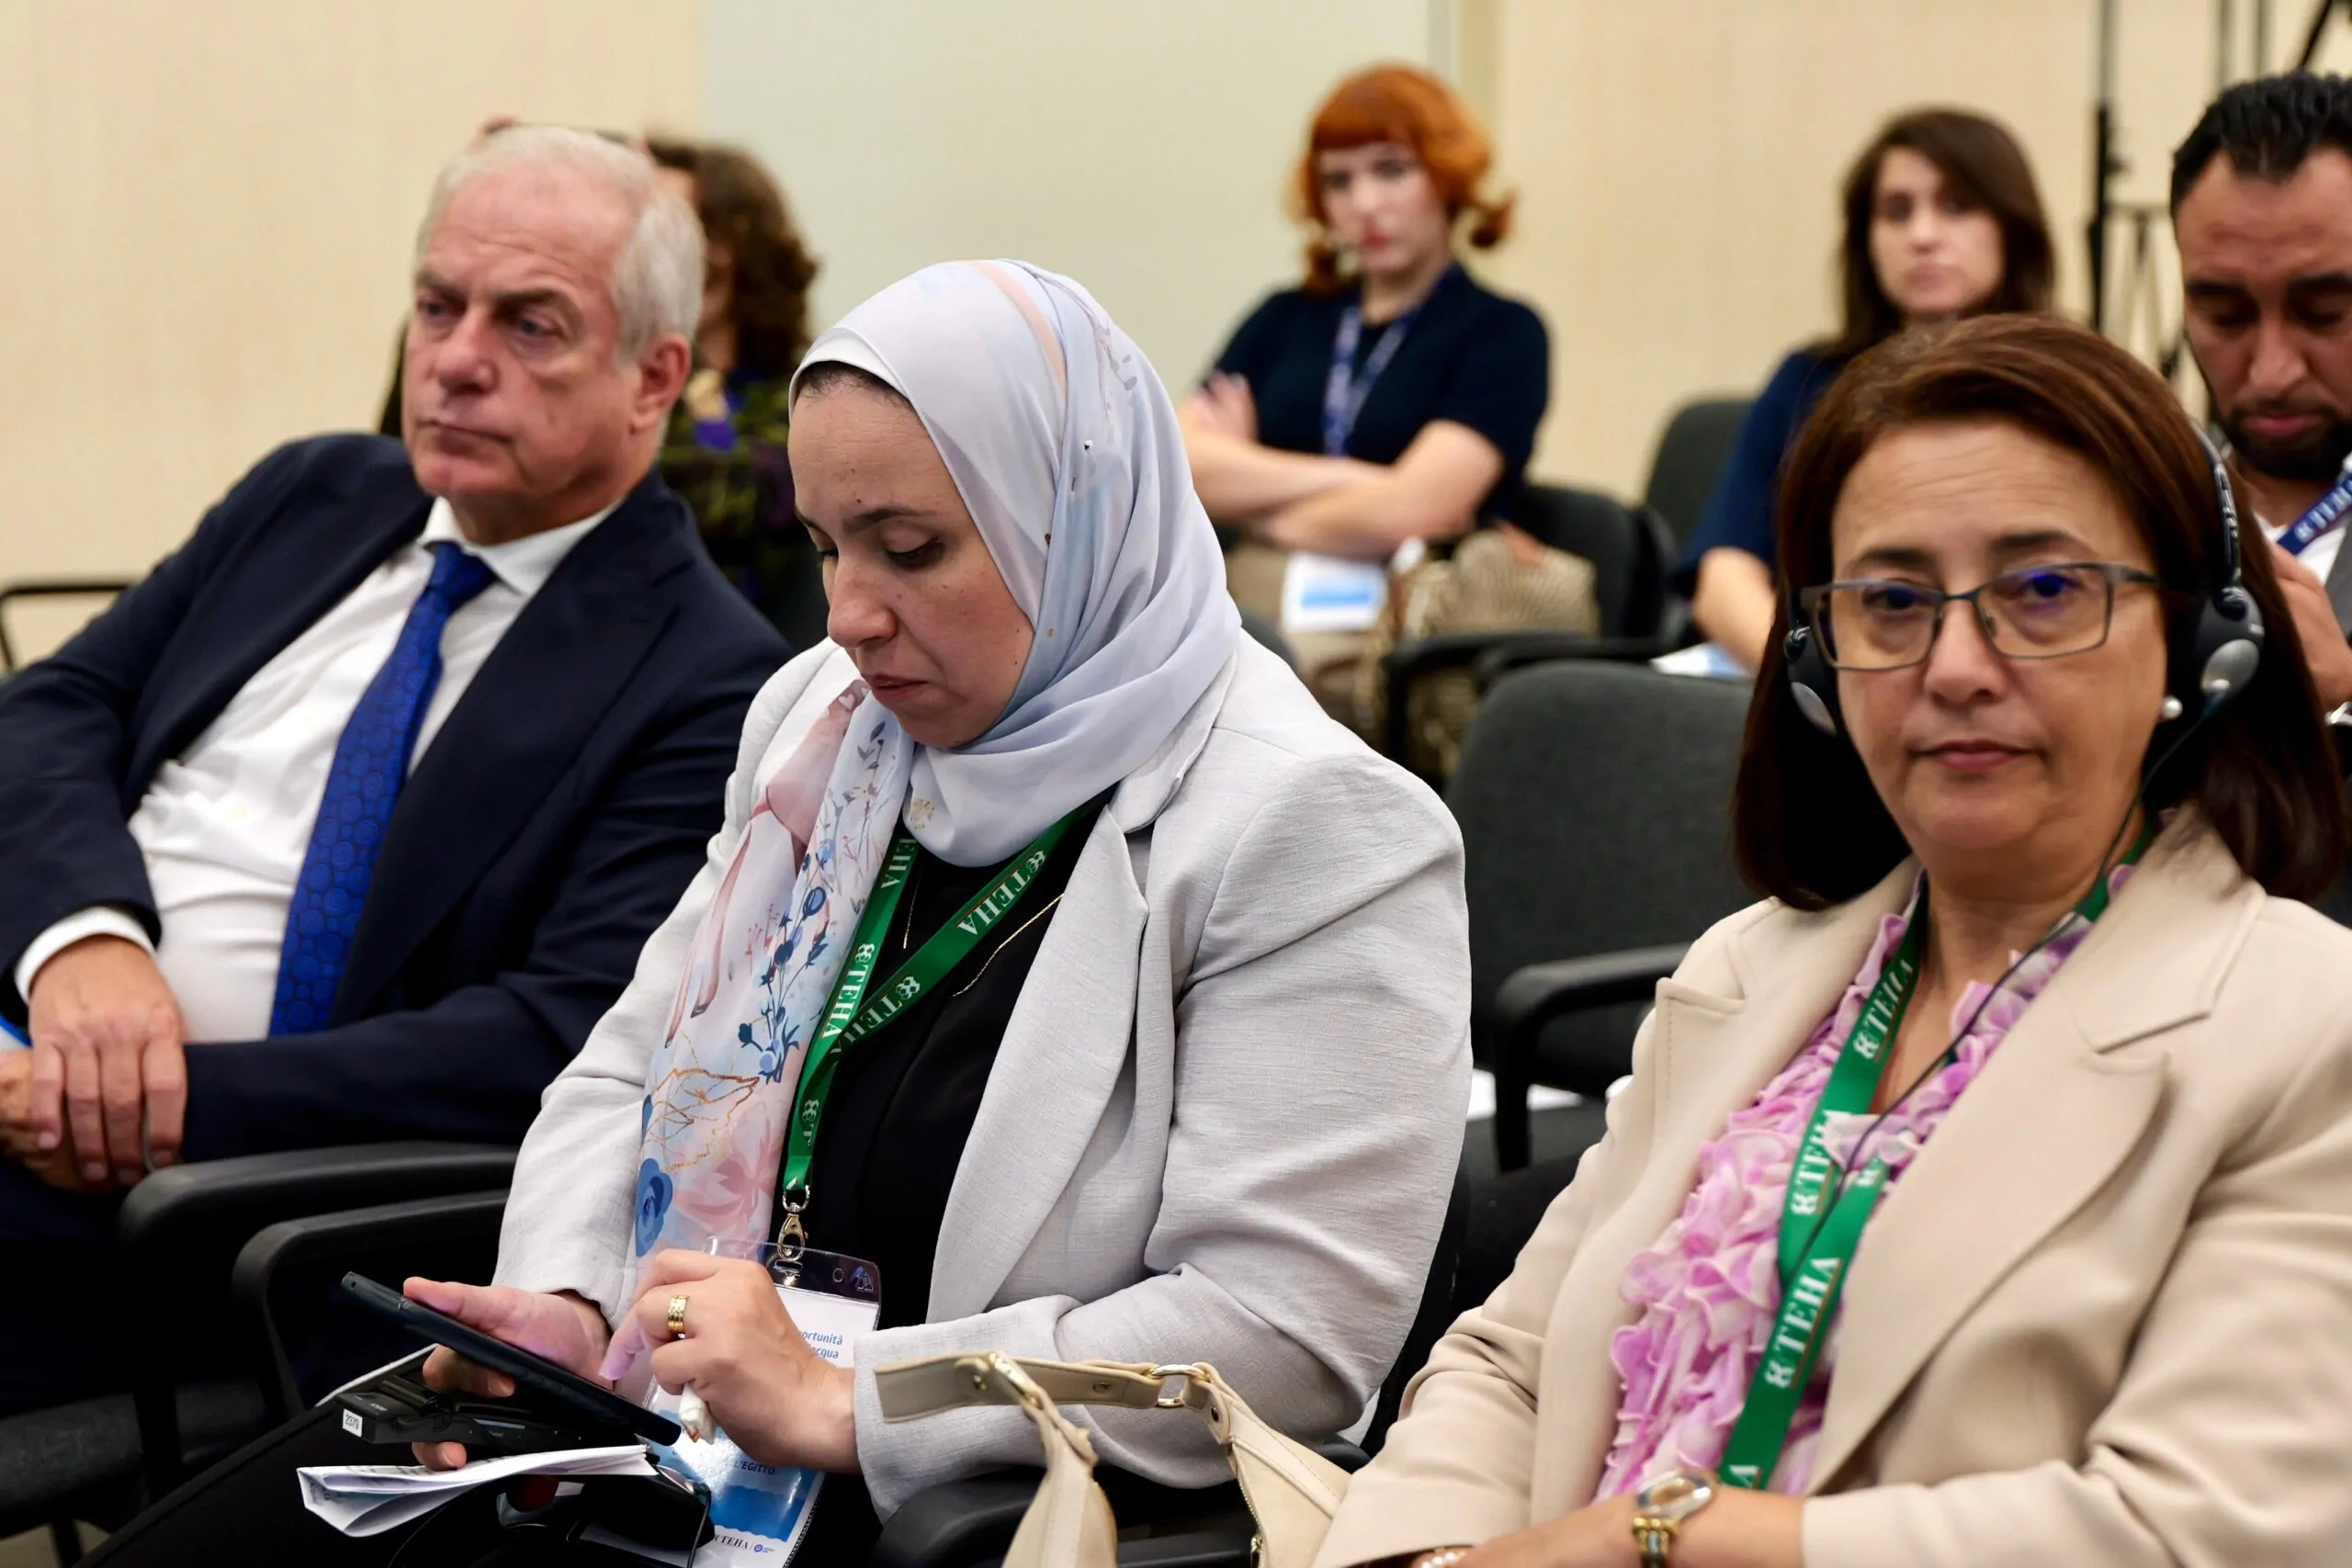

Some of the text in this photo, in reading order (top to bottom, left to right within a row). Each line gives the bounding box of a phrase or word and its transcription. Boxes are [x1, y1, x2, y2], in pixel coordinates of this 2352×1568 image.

[880, 838, 918, 889] EHA
[957, 869, 1030, 935] TEHA
[822, 964, 870, 1039] TEHA
[1773, 1257, 1840, 1353] TEHA
[798, 1330, 843, 1345] ortunità
[721, 1535, 749, 1549] TEHA
